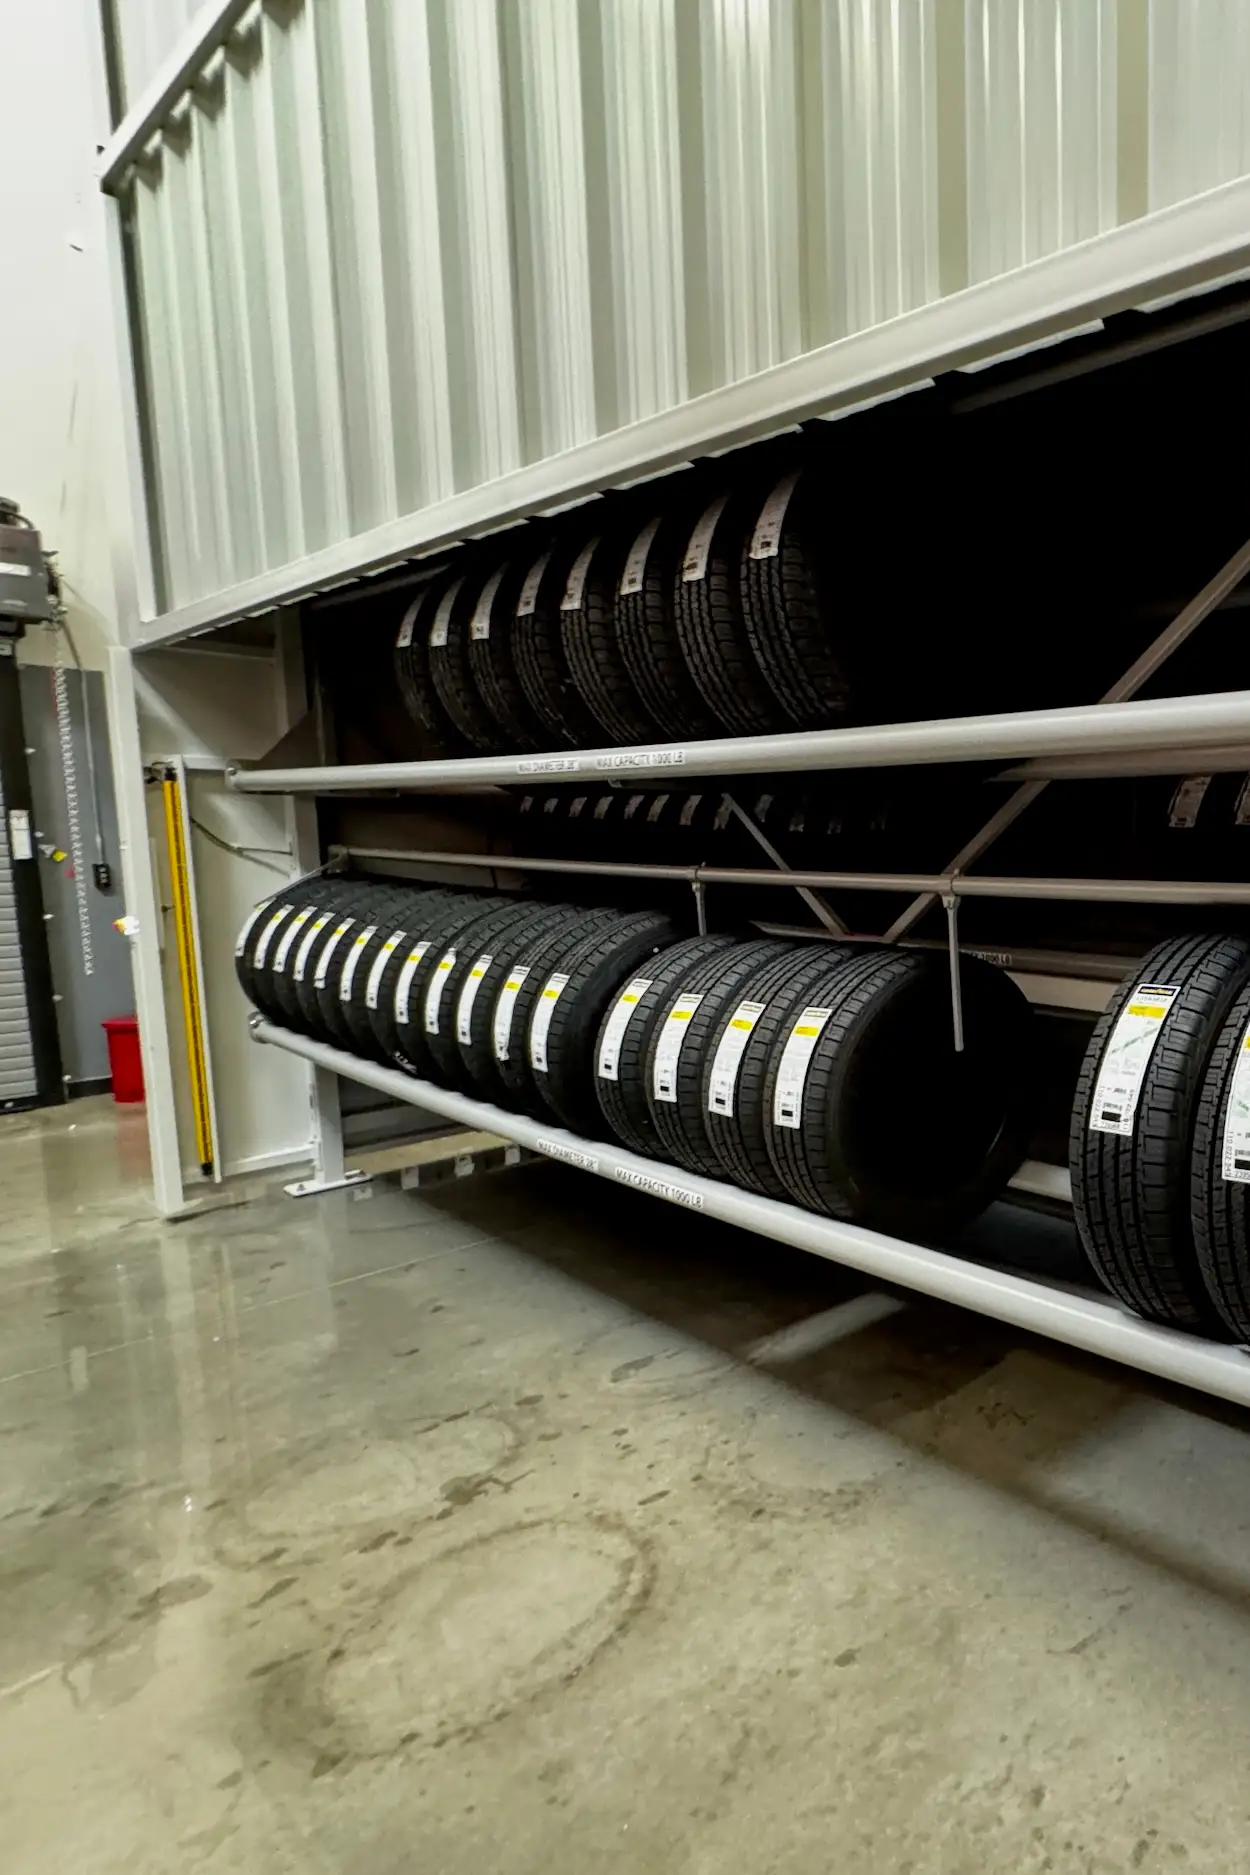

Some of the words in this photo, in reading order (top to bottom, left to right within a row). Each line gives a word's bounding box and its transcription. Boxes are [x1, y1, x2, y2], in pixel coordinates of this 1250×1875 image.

[598, 757, 612, 768] MAX
[615, 754, 650, 767] CAPACITY
[652, 752, 672, 765] 1000
[553, 1145, 584, 1163] DIAMETER
[616, 1168, 631, 1182] MAX
[633, 1174, 669, 1195] CAPACITY
[671, 1188, 690, 1204] 1000
[691, 1195, 702, 1208] LB
